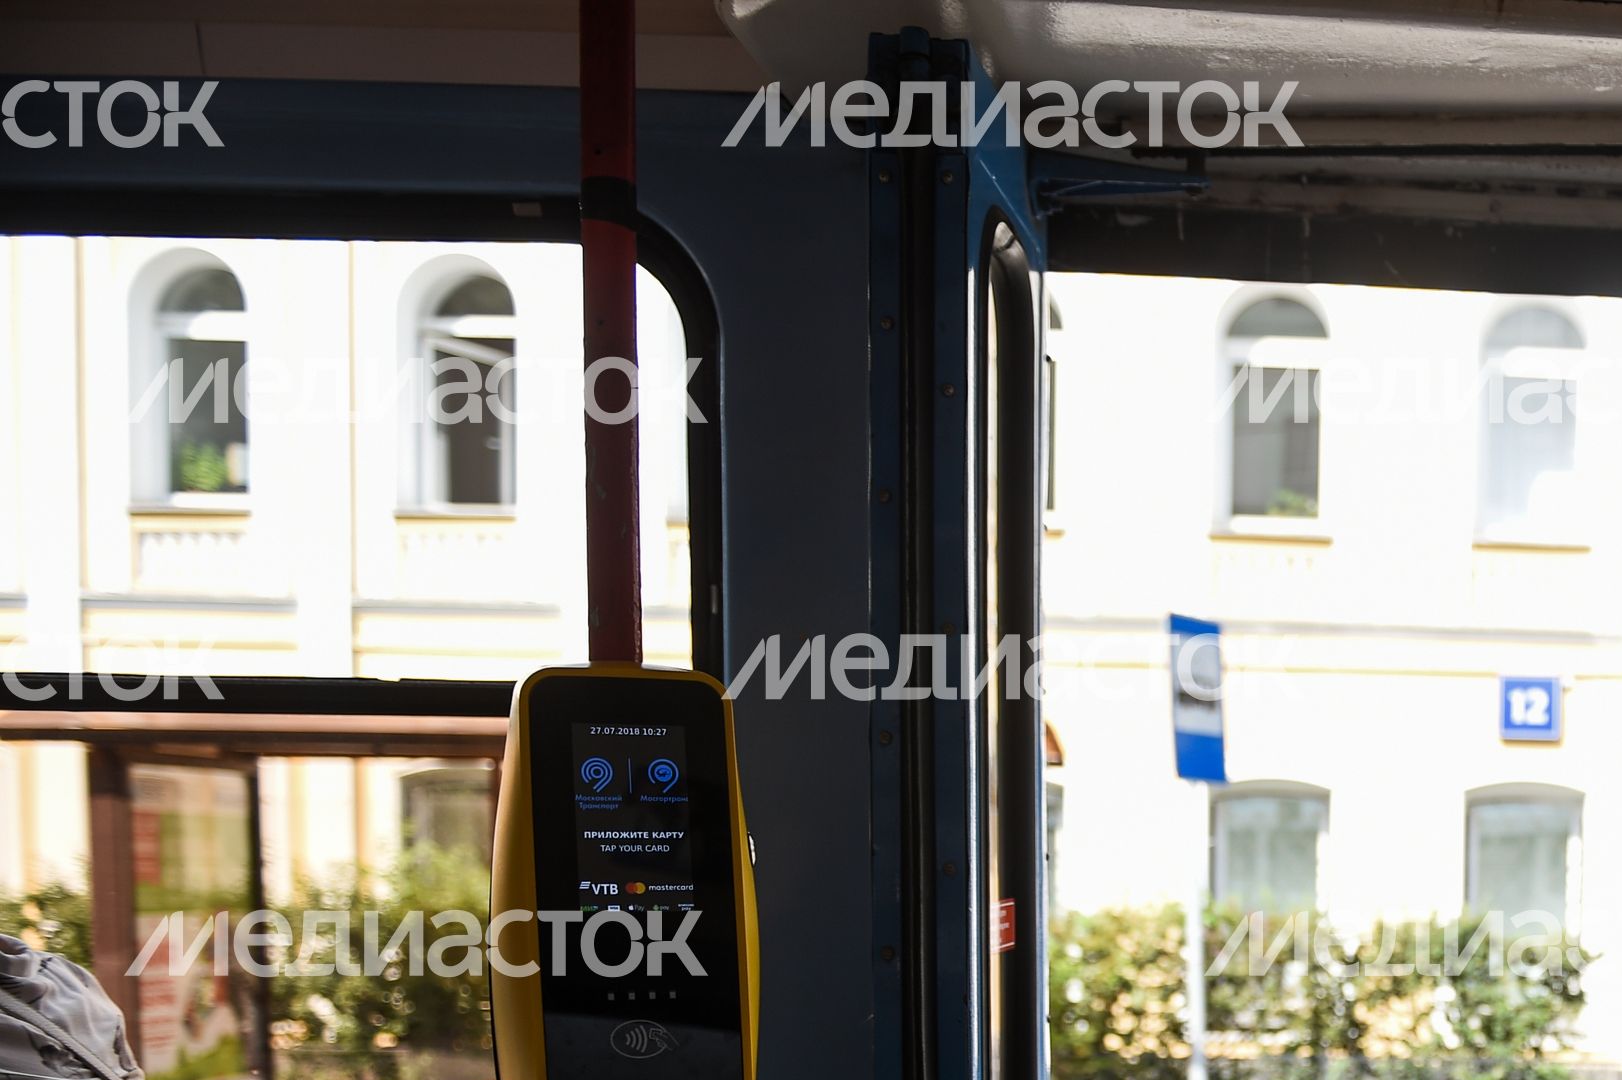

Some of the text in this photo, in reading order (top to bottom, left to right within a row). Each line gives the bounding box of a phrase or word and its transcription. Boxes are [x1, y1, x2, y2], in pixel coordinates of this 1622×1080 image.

[1510, 687, 1550, 725] 12
[590, 726, 667, 736] 27.07.2018 10:27
[579, 802, 619, 810] Транспорт
[584, 831, 684, 839] ПРИЛОЖИТЕ КАРТУ
[600, 844, 616, 852] TAP
[591, 883, 619, 895] VTB
